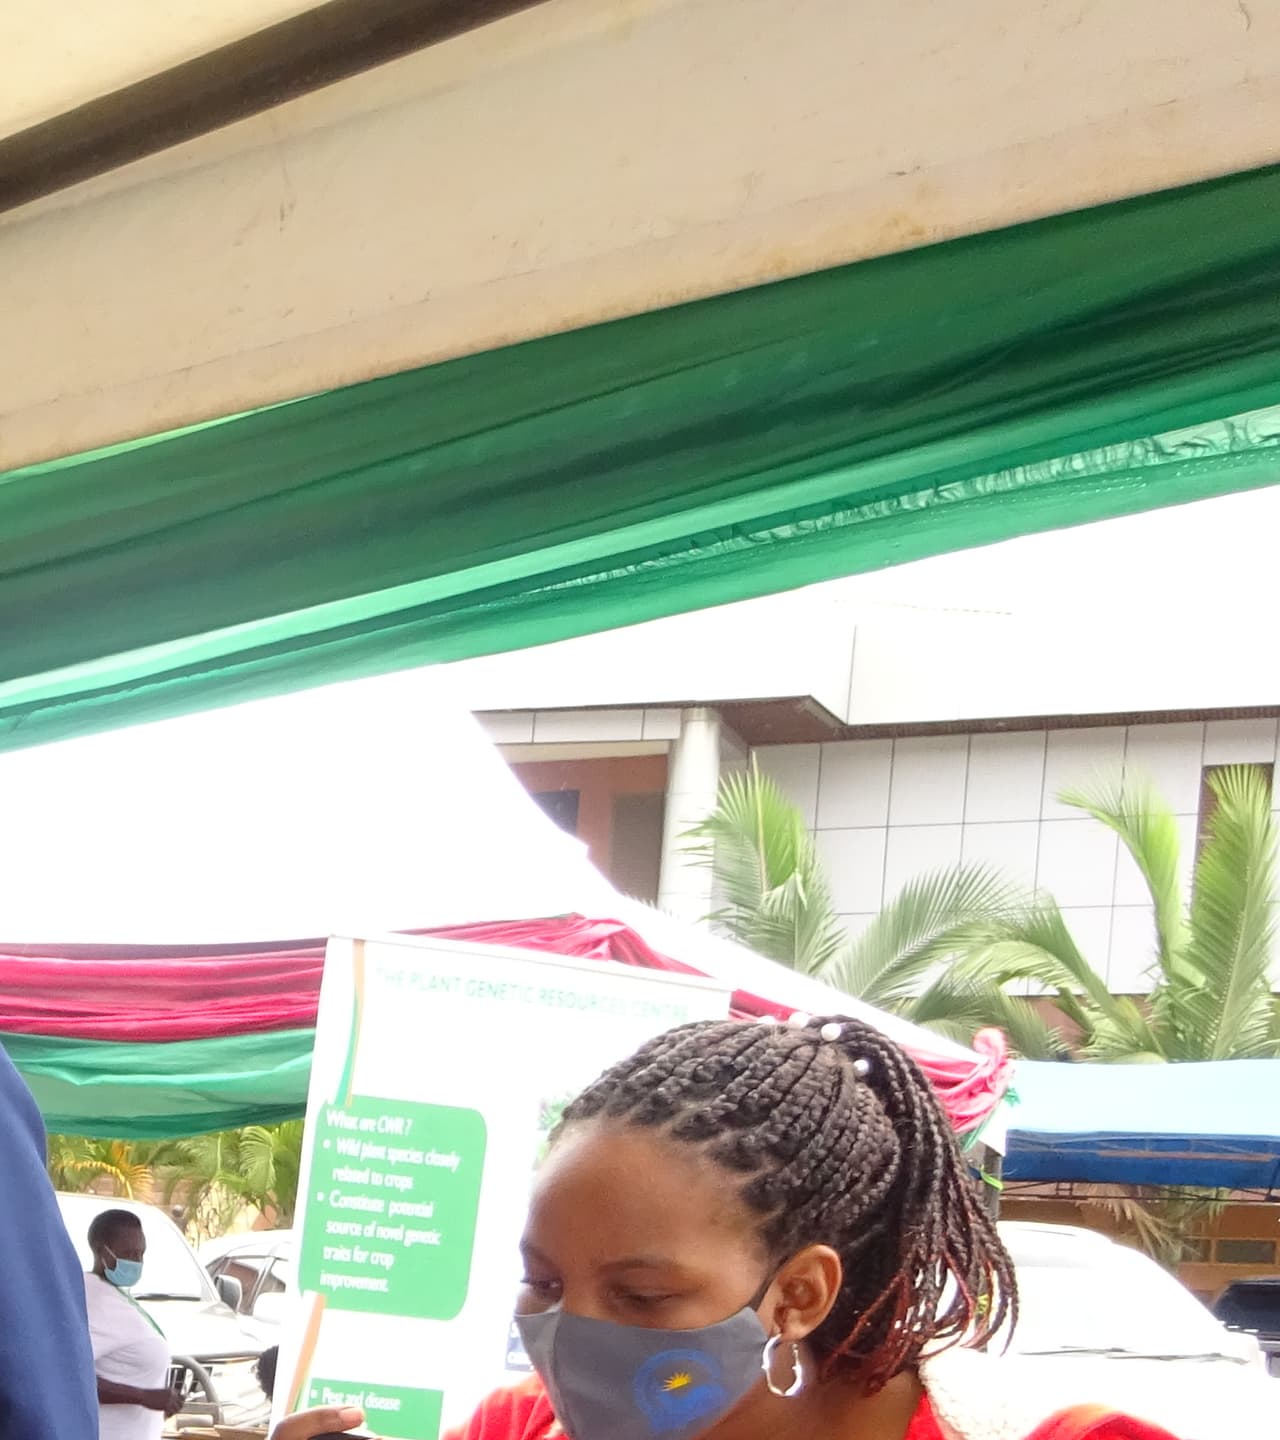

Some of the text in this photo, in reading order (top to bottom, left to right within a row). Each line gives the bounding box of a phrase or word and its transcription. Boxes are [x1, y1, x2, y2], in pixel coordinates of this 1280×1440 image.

[326, 1110, 357, 1130] What
[336, 1137, 461, 1173] Wild plant species closely
[332, 1165, 413, 1192] related to crops
[388, 1199, 434, 1219] potential
[325, 1220, 362, 1236] source
[363, 1220, 376, 1237] of
[376, 1224, 404, 1241] novel
[322, 1244, 395, 1271] traits for crop
[322, 1387, 345, 1405] Pest
[365, 1392, 401, 1411] disease
